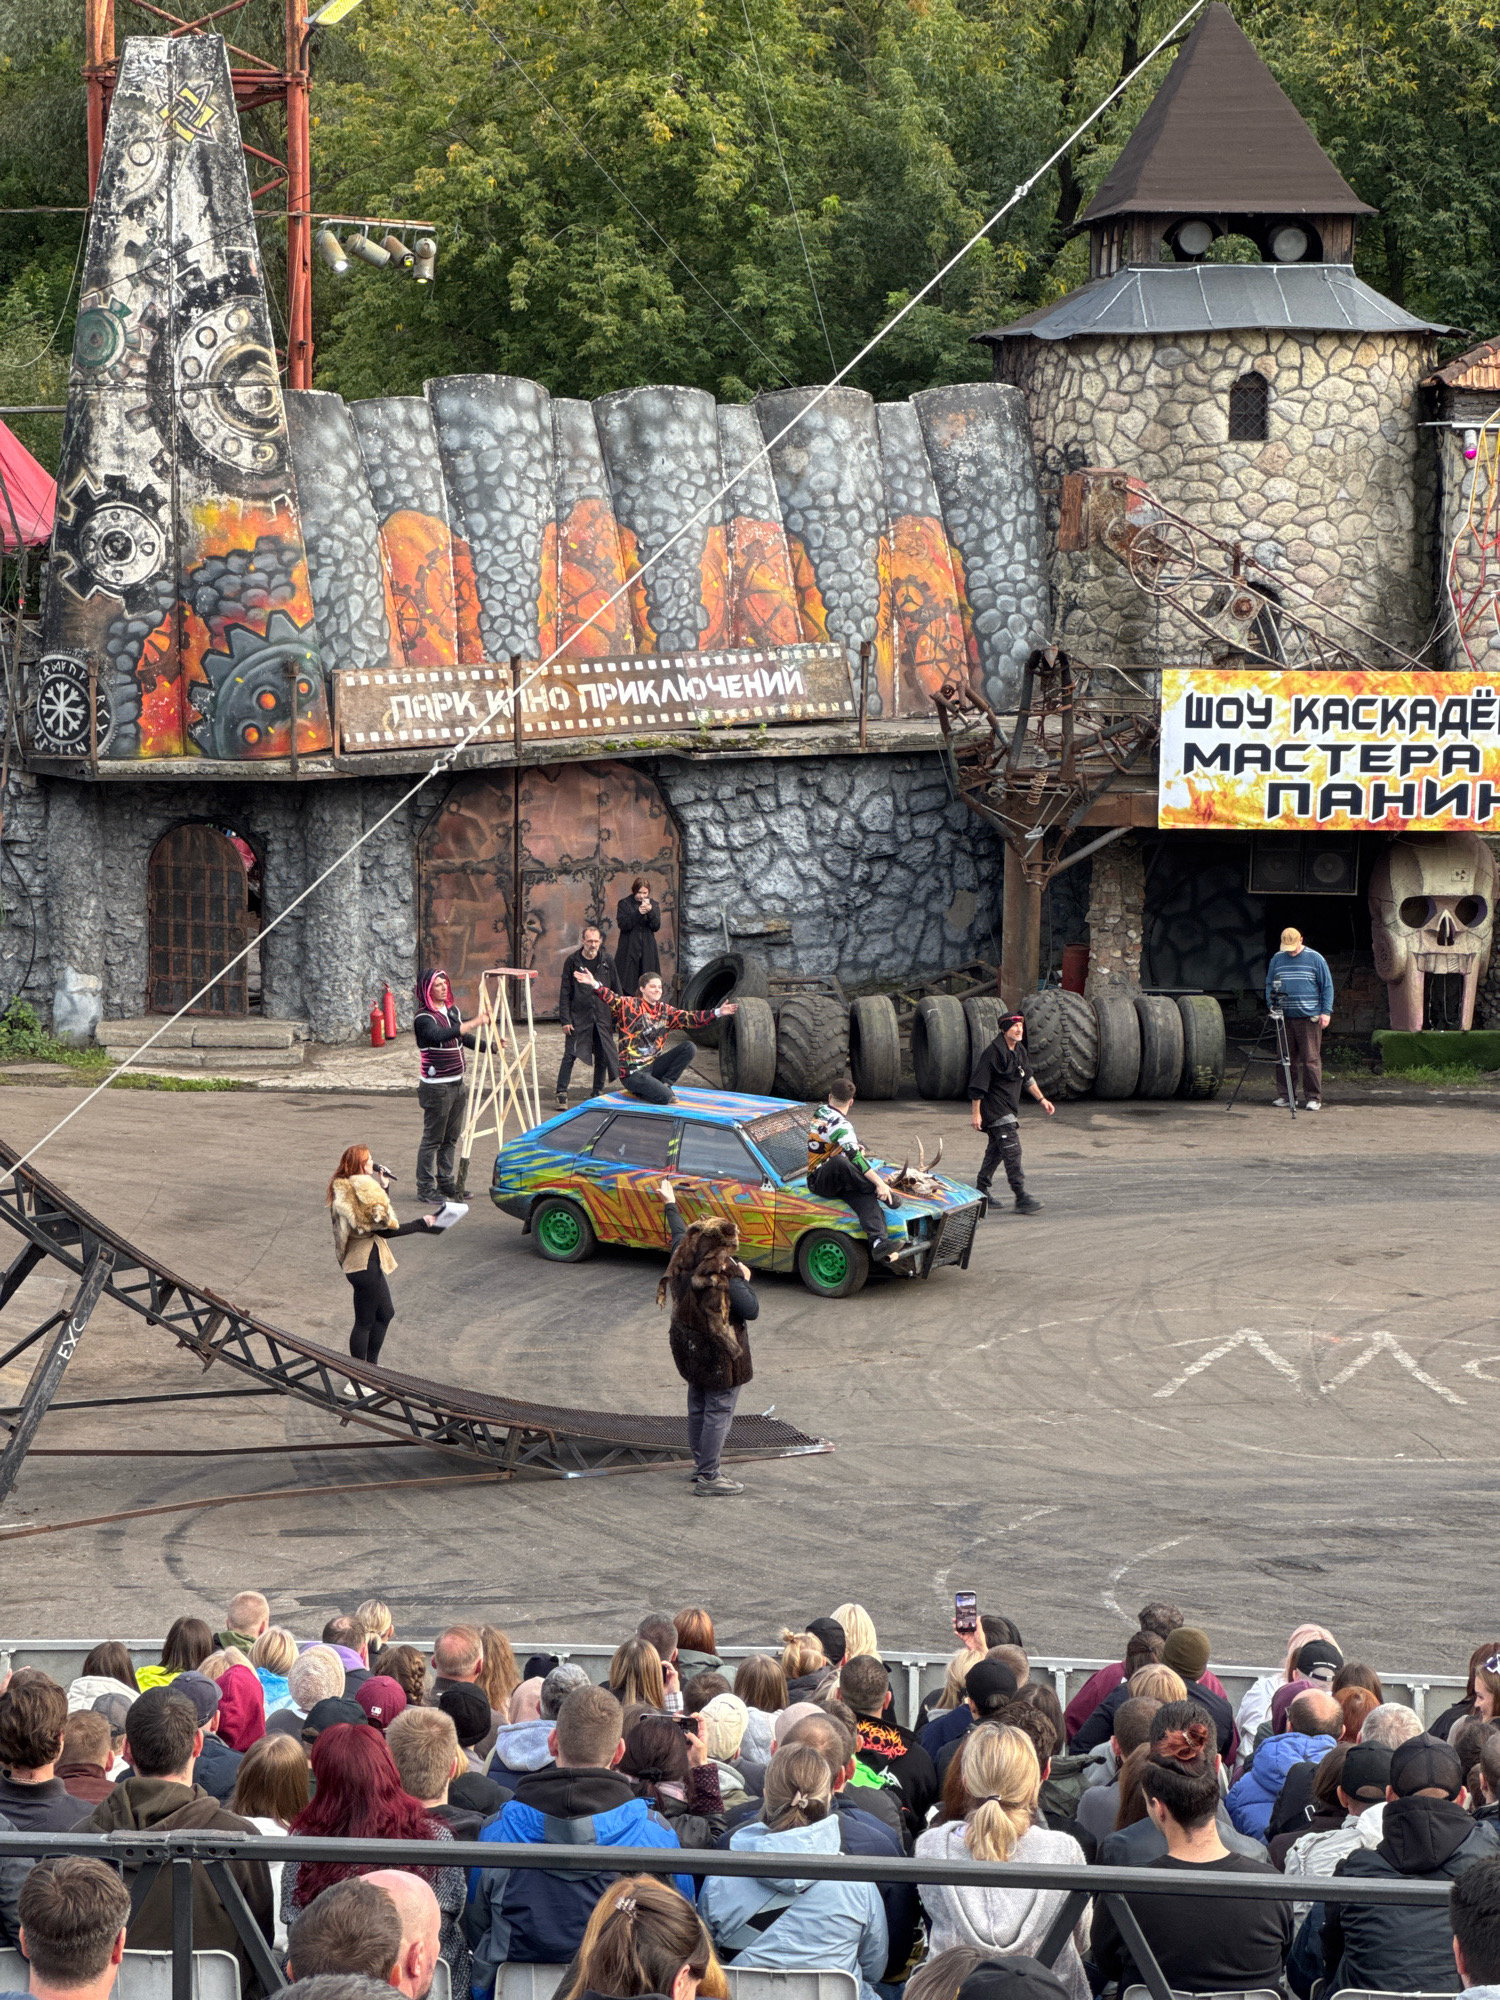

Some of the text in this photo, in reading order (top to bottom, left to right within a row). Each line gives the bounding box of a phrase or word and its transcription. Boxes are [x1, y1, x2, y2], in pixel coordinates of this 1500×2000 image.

[389, 665, 804, 725] ПАРК КИНО ПРИКЛЮЧЕНИЙ
[1185, 689, 1500, 739] ШОУ КАСКАДЁ
[1184, 742, 1481, 777] МАСТЕРА
